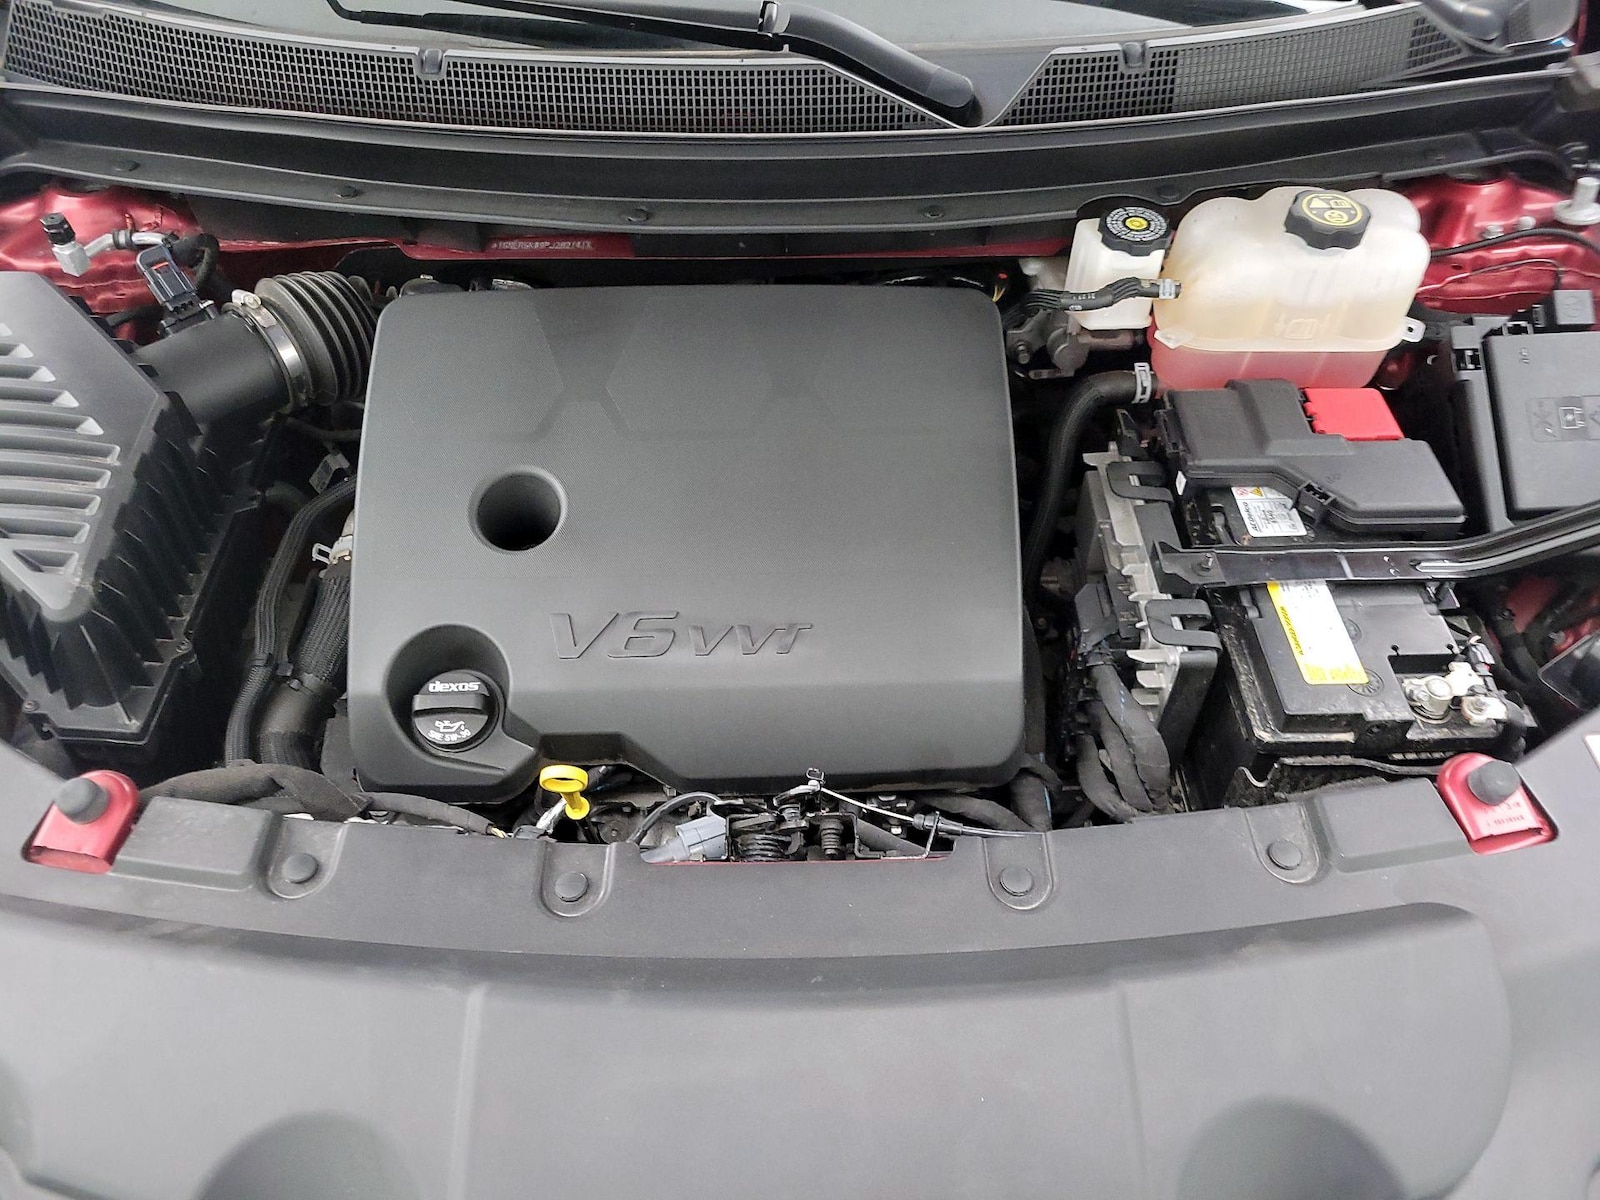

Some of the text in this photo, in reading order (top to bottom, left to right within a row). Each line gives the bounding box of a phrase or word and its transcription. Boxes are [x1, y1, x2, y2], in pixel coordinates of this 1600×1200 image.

[549, 610, 813, 660] V6 VVT
[428, 680, 481, 693] dexos
[427, 729, 444, 741] SAE
